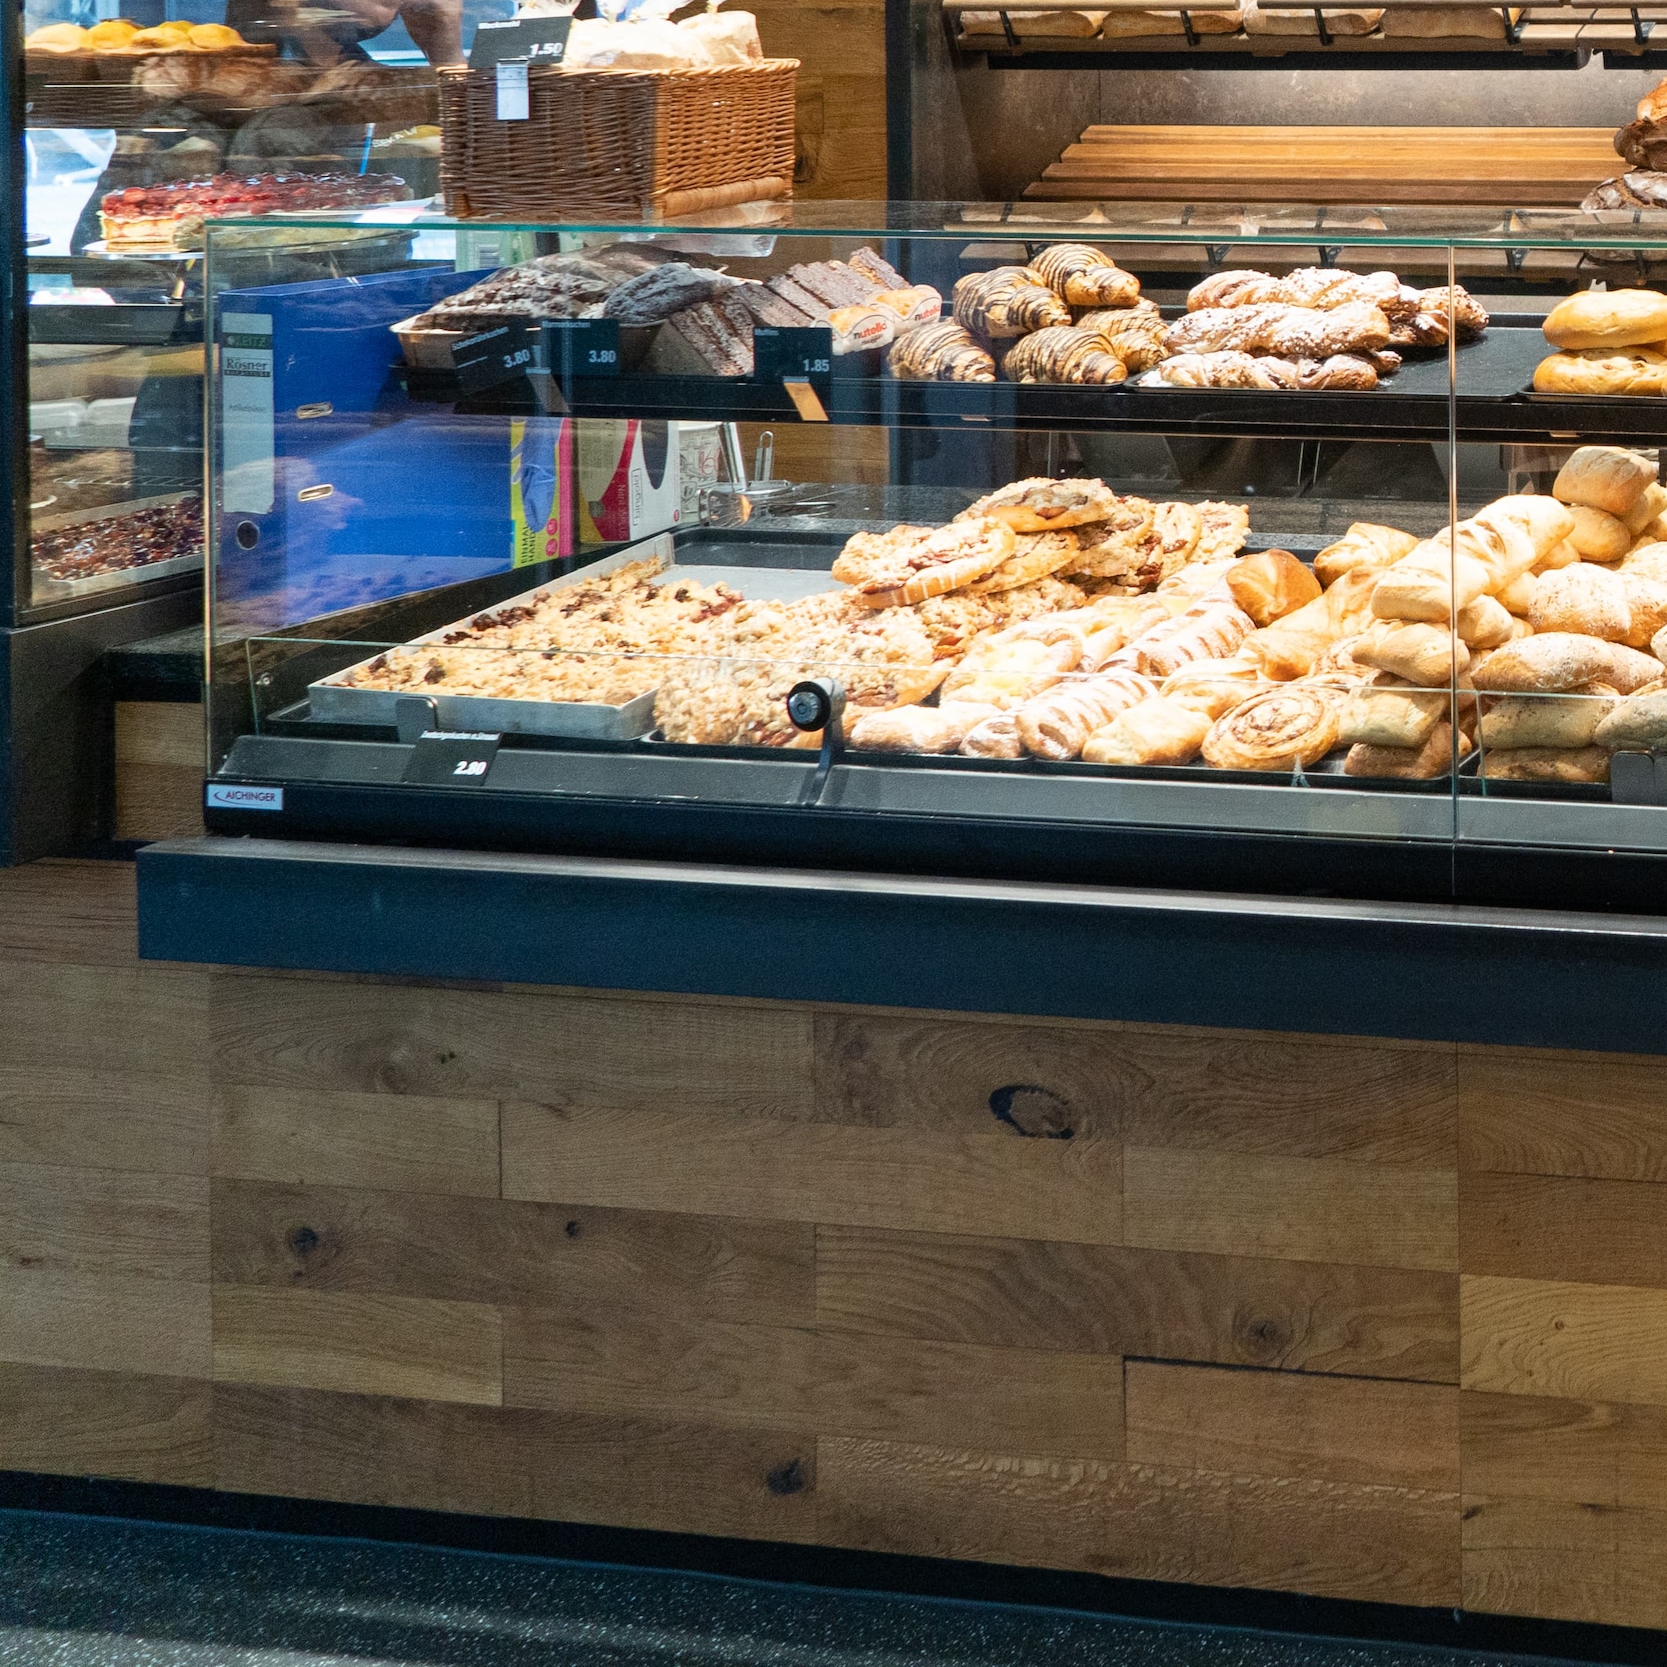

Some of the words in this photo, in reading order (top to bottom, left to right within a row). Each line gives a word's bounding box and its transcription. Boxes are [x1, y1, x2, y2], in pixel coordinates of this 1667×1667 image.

[530, 42, 563, 55] 1.50
[503, 349, 531, 368] 3.80
[588, 350, 617, 363] 3.80
[226, 357, 269, 371] Rösner
[802, 358, 830, 372] 1.85
[453, 760, 488, 776] 2.80
[225, 789, 276, 802] AICHINGER
